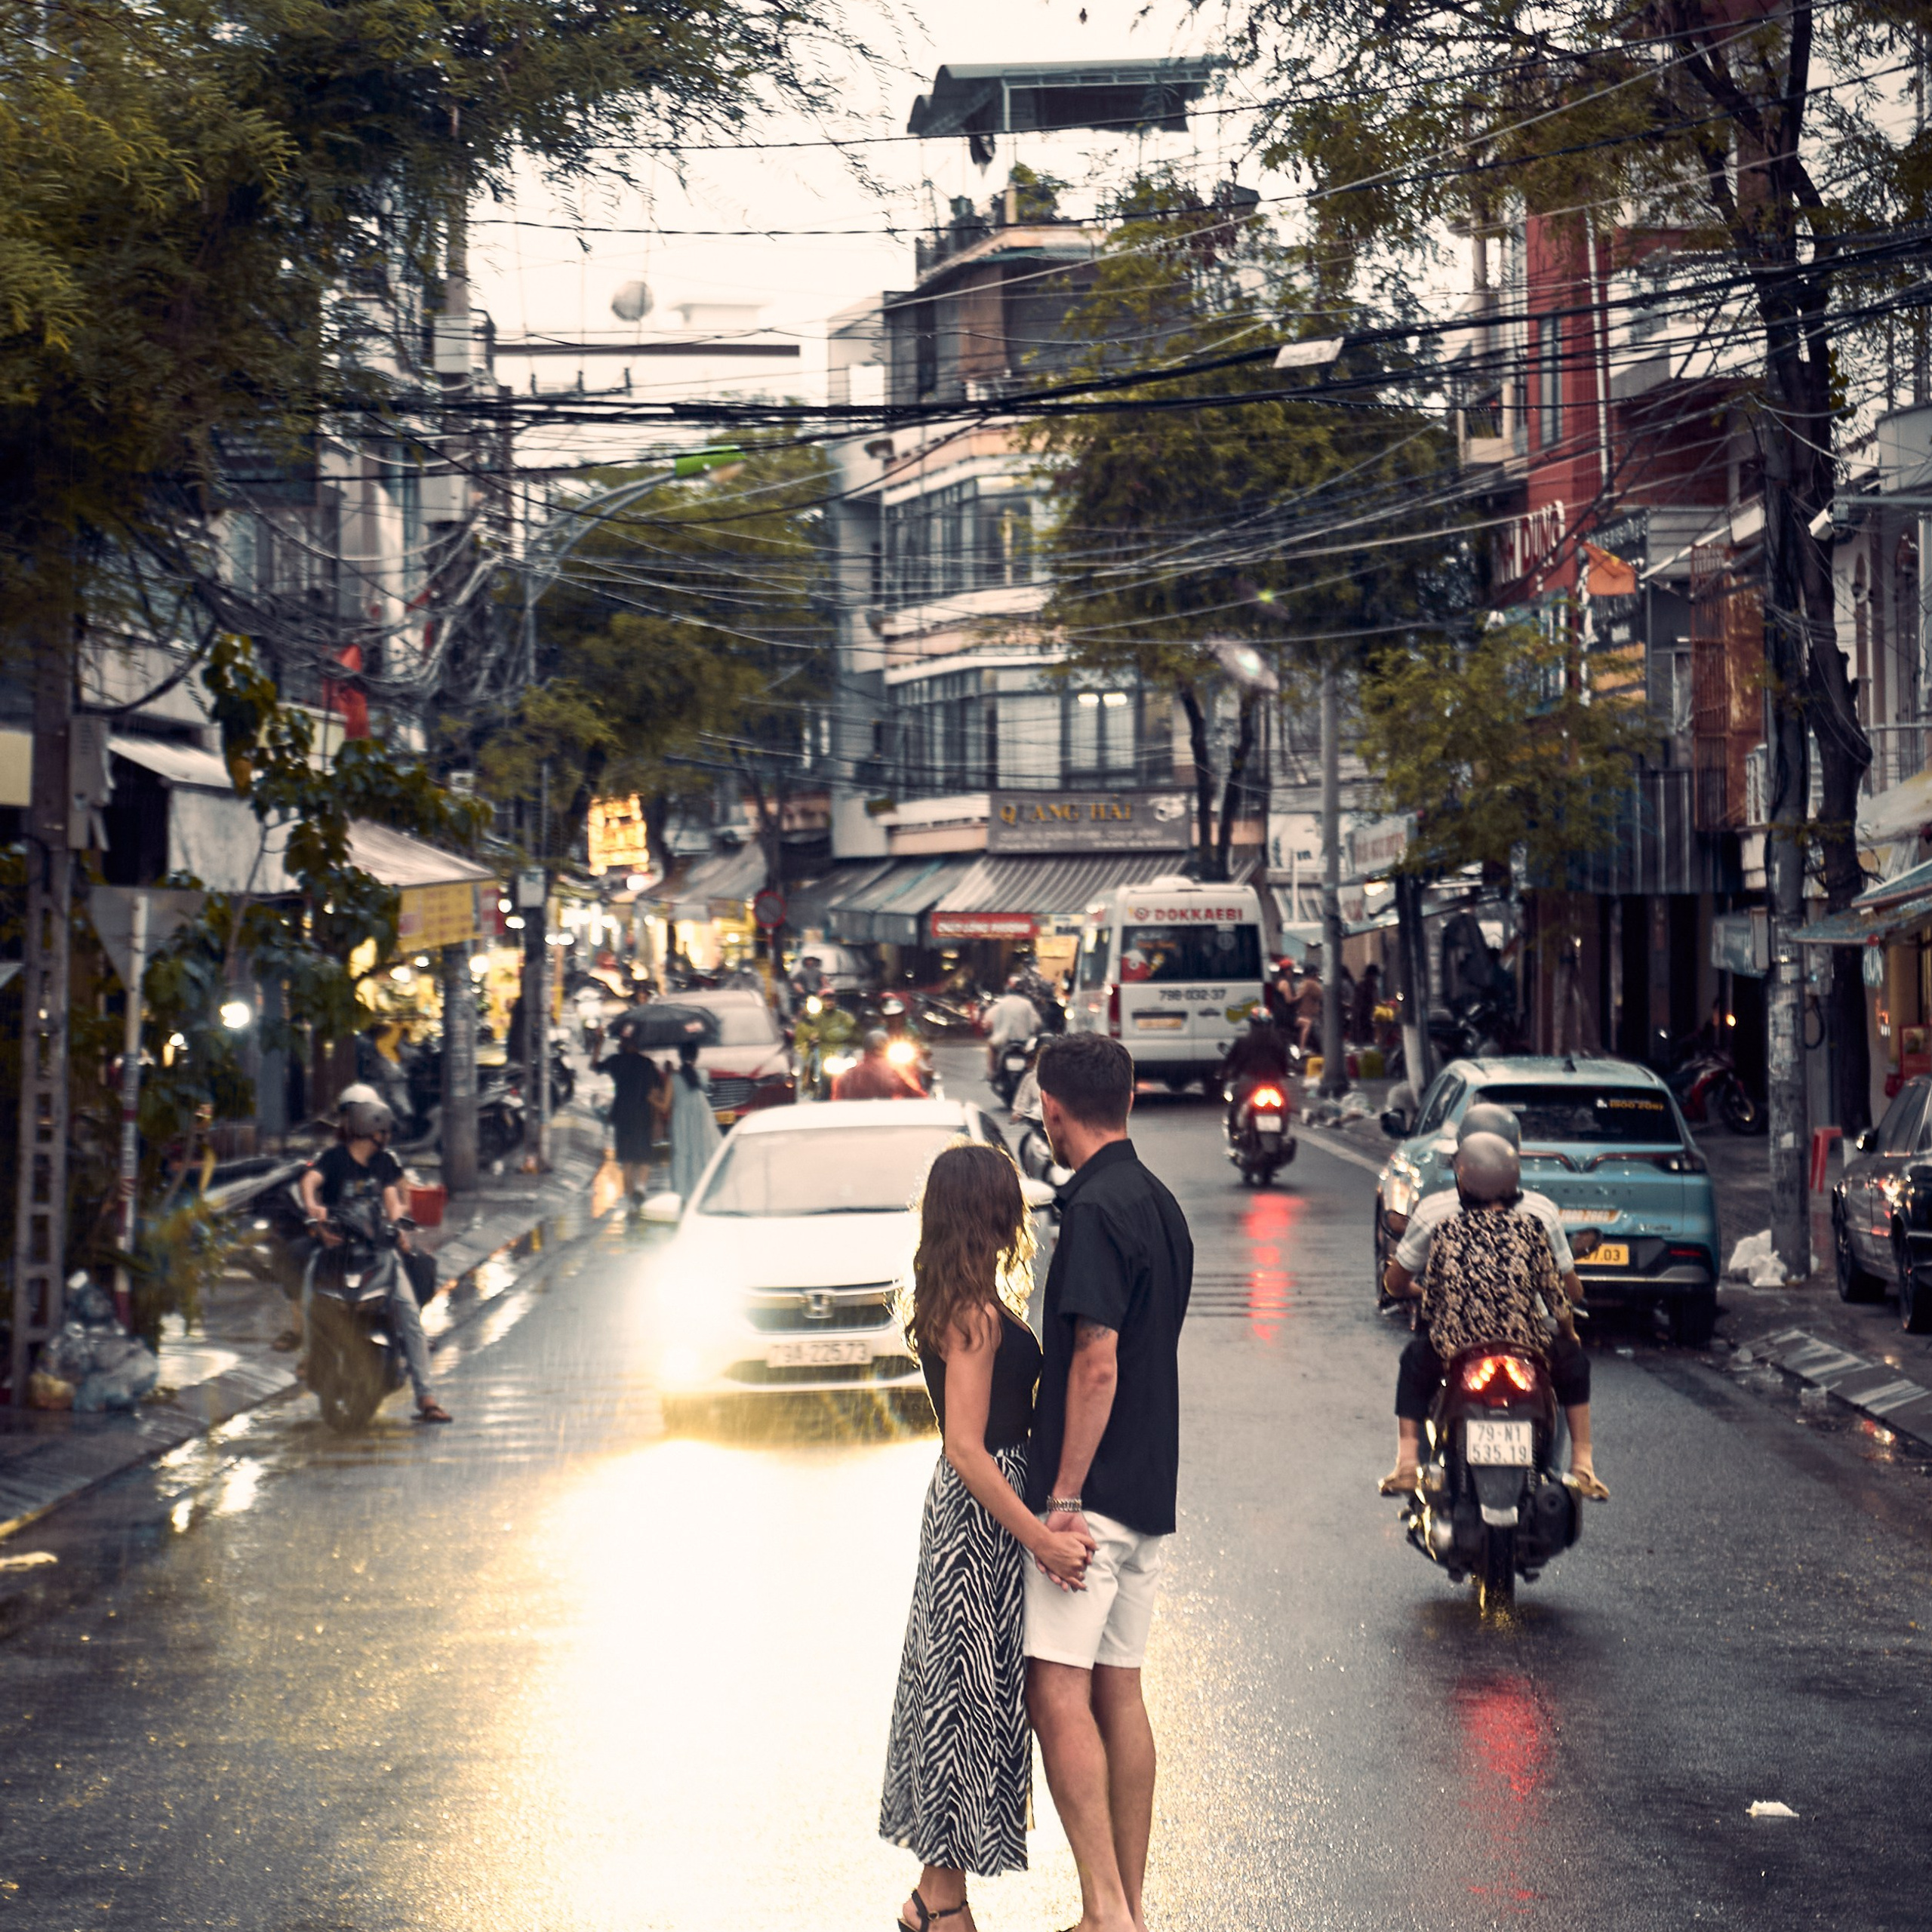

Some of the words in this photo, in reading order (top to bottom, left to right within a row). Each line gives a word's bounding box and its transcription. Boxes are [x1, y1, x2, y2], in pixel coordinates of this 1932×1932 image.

[1155, 907, 1243, 921] DOKKAEBI
[1477, 1424, 1521, 1442] 79-N1
[1472, 1444, 1527, 1464] 535.19
